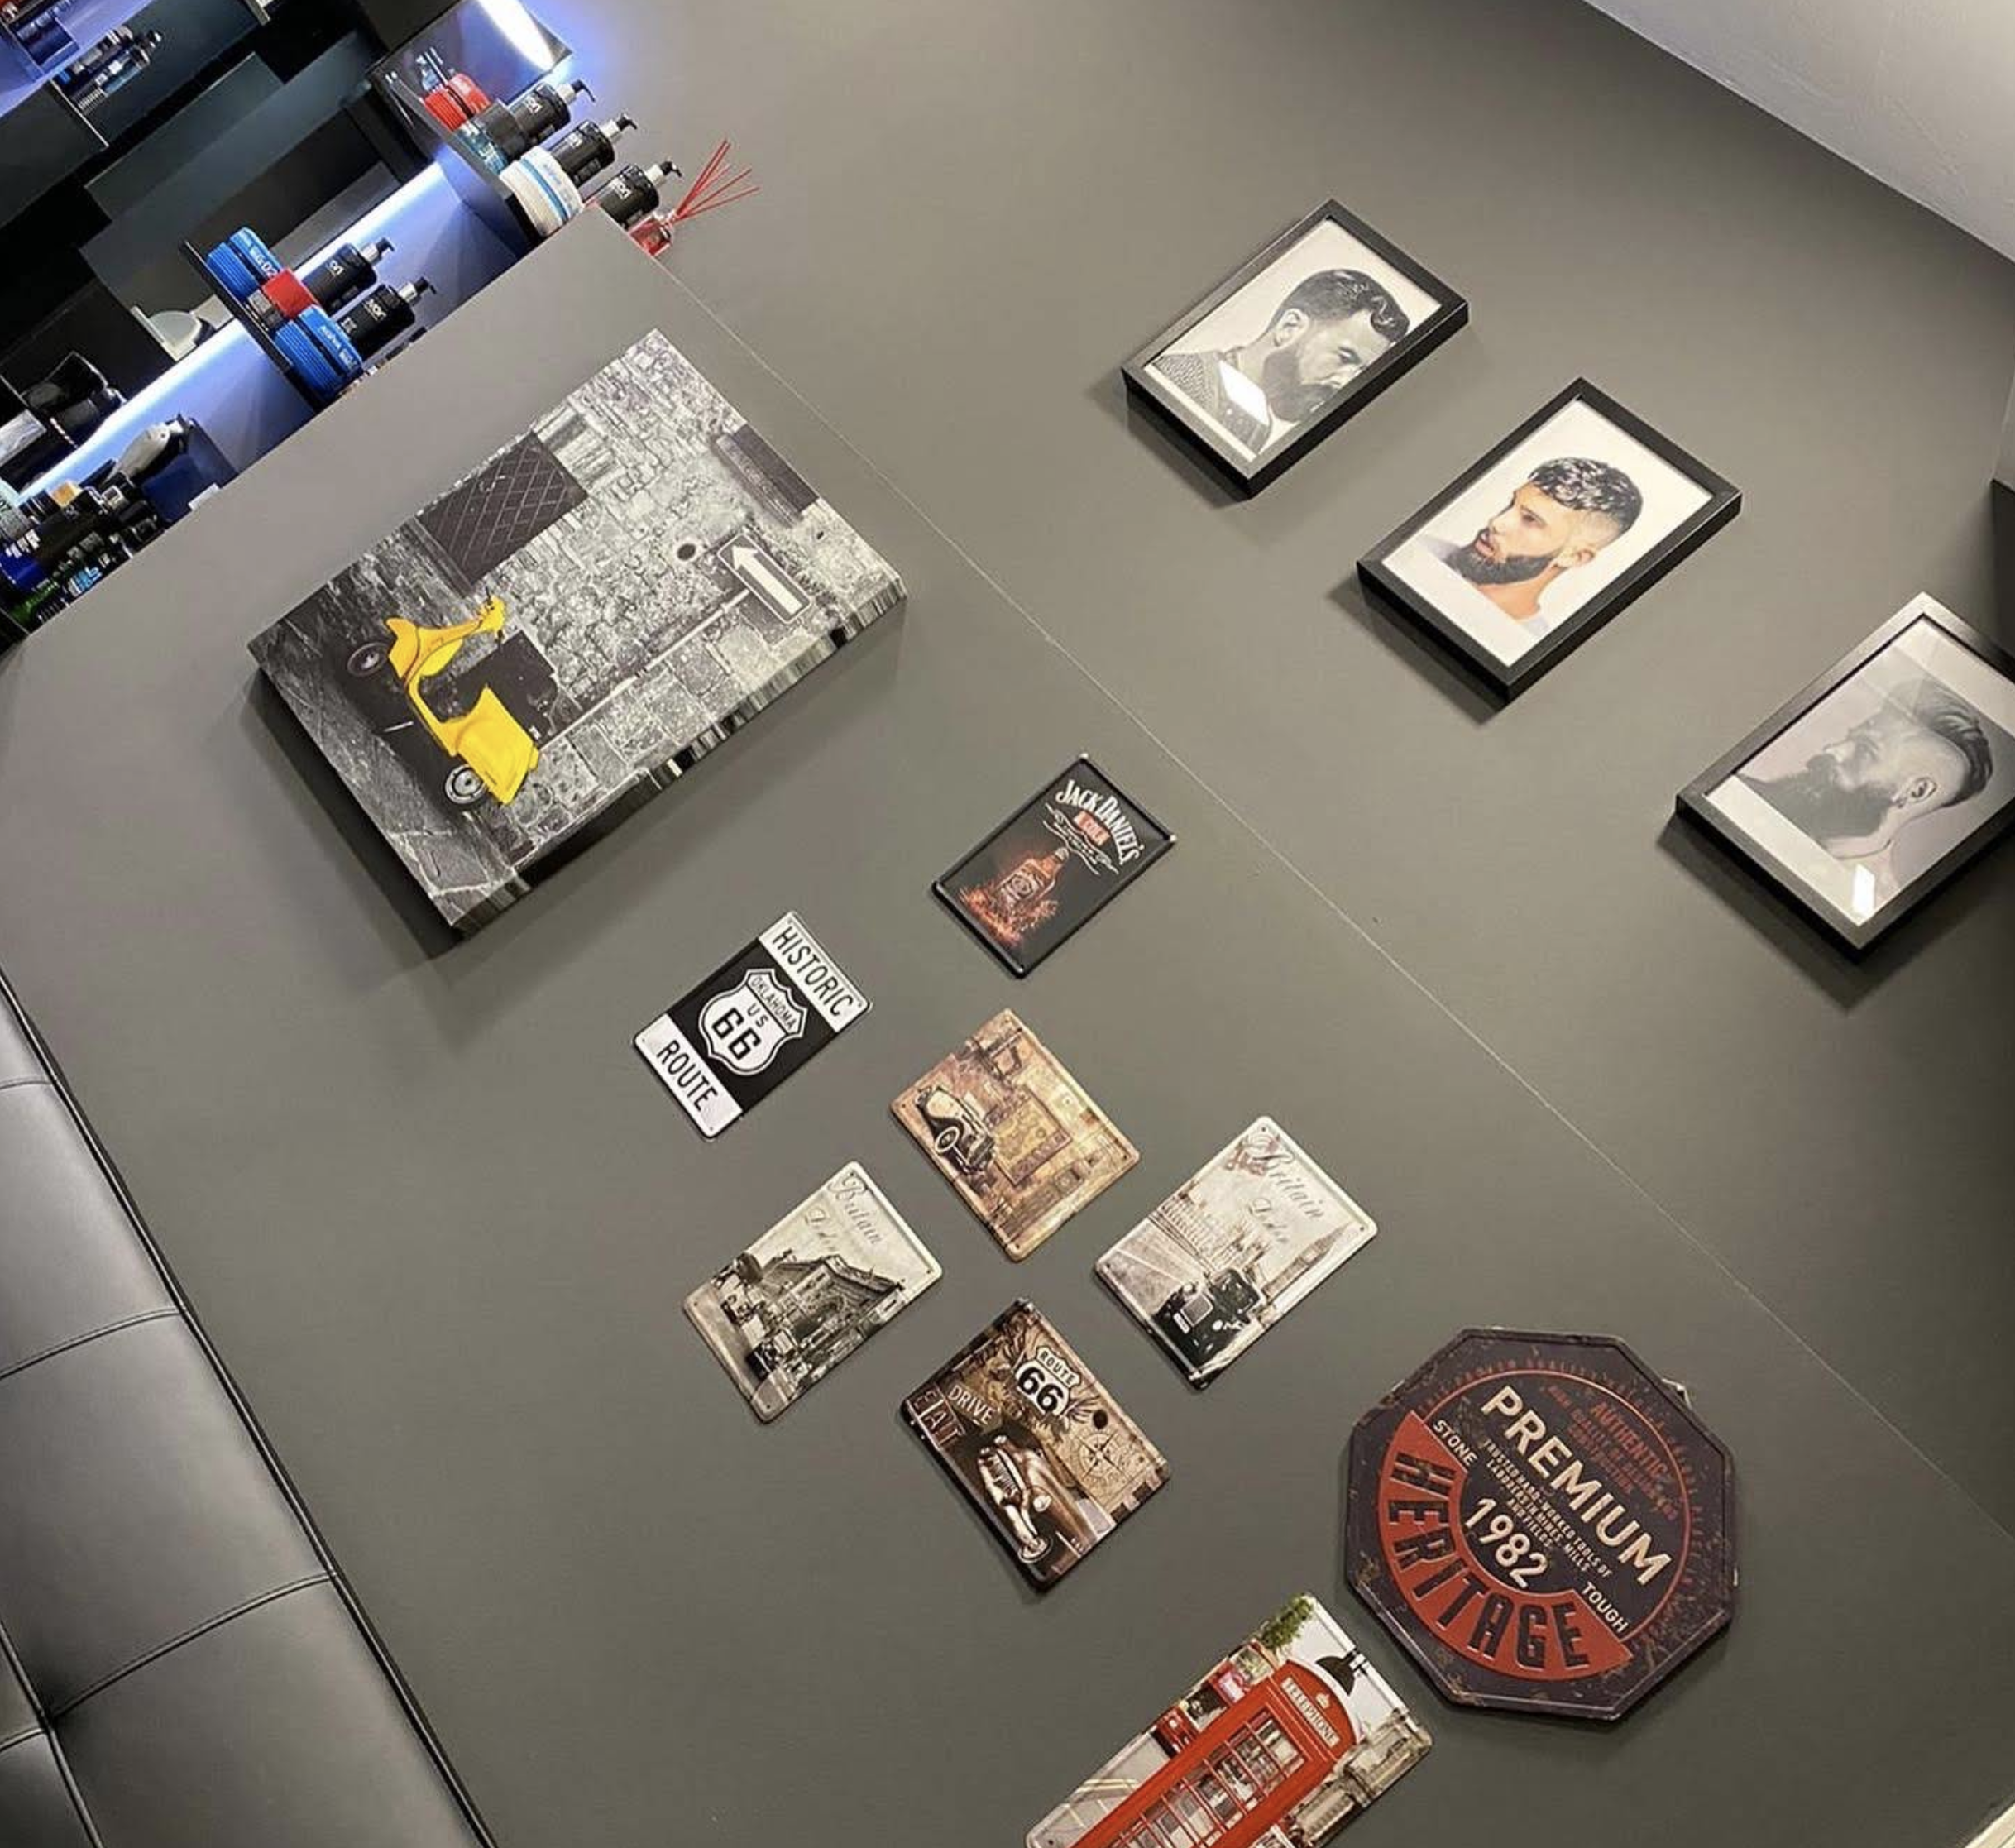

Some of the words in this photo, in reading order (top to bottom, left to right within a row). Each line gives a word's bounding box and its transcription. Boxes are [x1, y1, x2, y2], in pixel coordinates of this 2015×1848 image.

[1055, 780, 1102, 811] JACK
[1094, 796, 1144, 864] DANIEL'S
[751, 976, 796, 1029] OKLAHOMA
[773, 926, 853, 1017] HISTORIC
[712, 1007, 761, 1060] 66
[657, 1040, 717, 1111] ROUTE
[1245, 1138, 1323, 1219] Britain
[949, 1385, 996, 1424] DRIVE
[1019, 1367, 1064, 1415] 66
[1040, 1352, 1076, 1386] ROUTE
[1433, 1420, 1478, 1467] STONE
[1593, 1402, 1667, 1477] AUTHENTIC
[1481, 1386, 1672, 1586] PREMIUM
[1482, 1439, 1520, 1478] TRUSTED
[1573, 1537, 1601, 1566] TOOLS
[1597, 1563, 1612, 1578] OF
[1487, 1459, 1529, 1504] LABORERS
[1563, 1544, 1591, 1572] MILLS
[1389, 1452, 1589, 1668] HERITAGE
[1465, 1498, 1548, 1587] 1982
[1581, 1582, 1627, 1634] TOUGH
[1286, 1681, 1335, 1743] TELEPHONE
